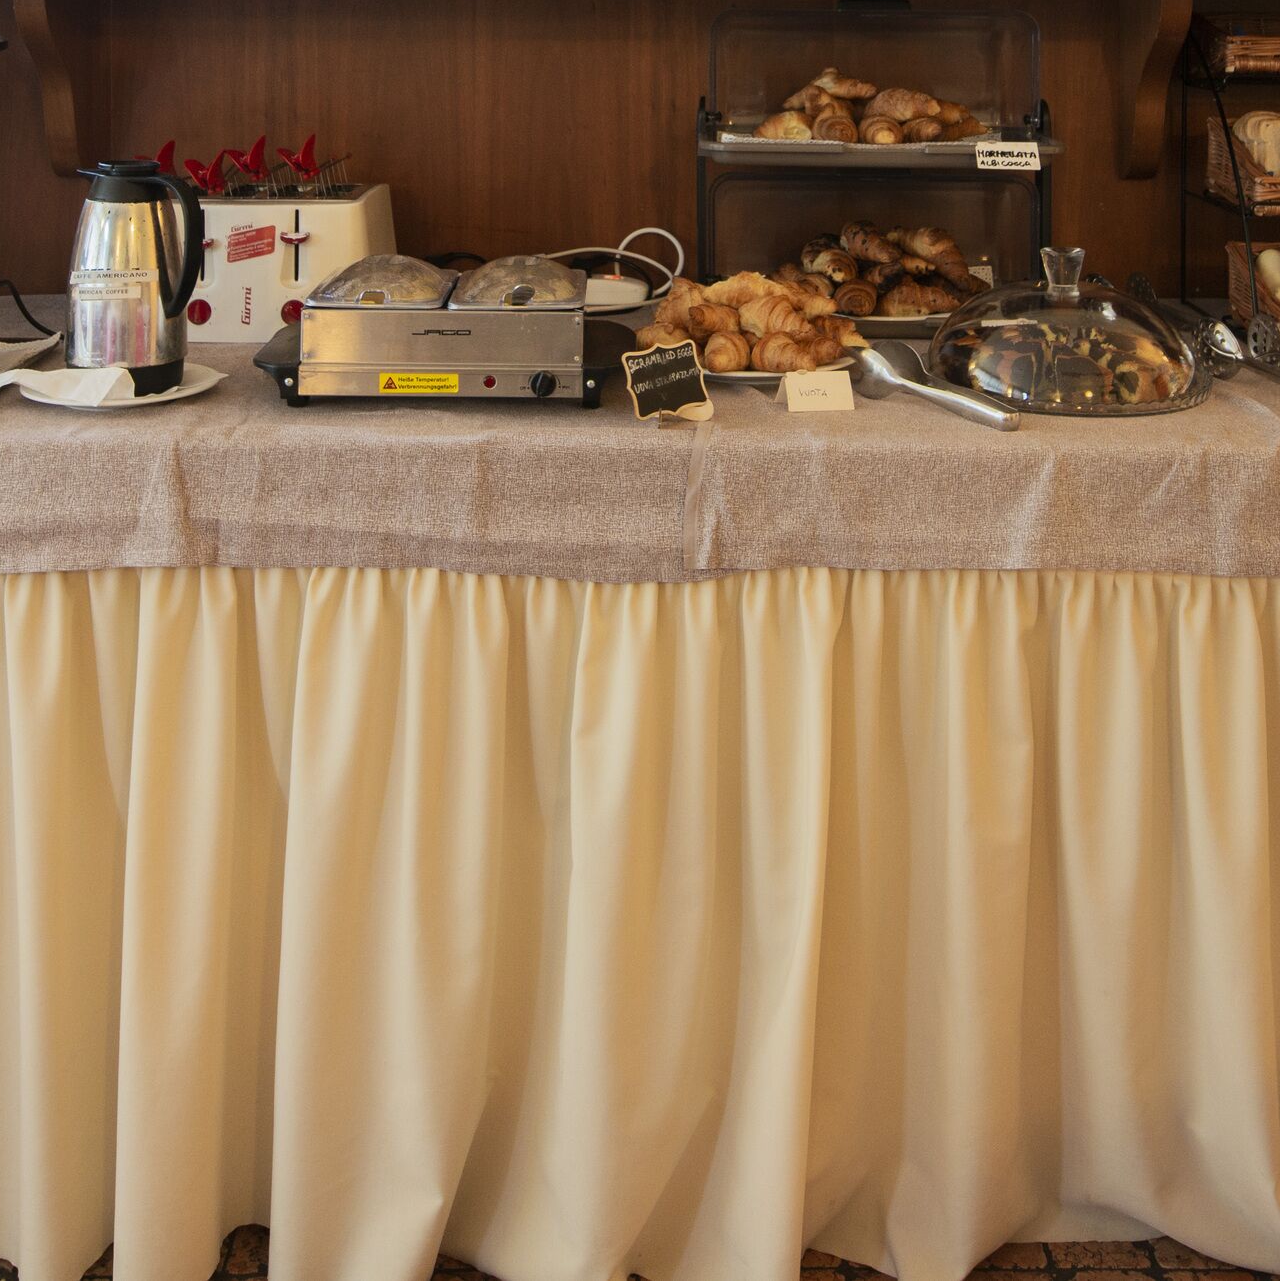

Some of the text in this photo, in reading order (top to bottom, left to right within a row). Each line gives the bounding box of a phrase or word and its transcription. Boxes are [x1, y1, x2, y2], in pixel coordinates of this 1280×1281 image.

[96, 271, 148, 279] AMERICANO
[241, 286, 252, 325] Girmi
[676, 346, 694, 359] EGGS
